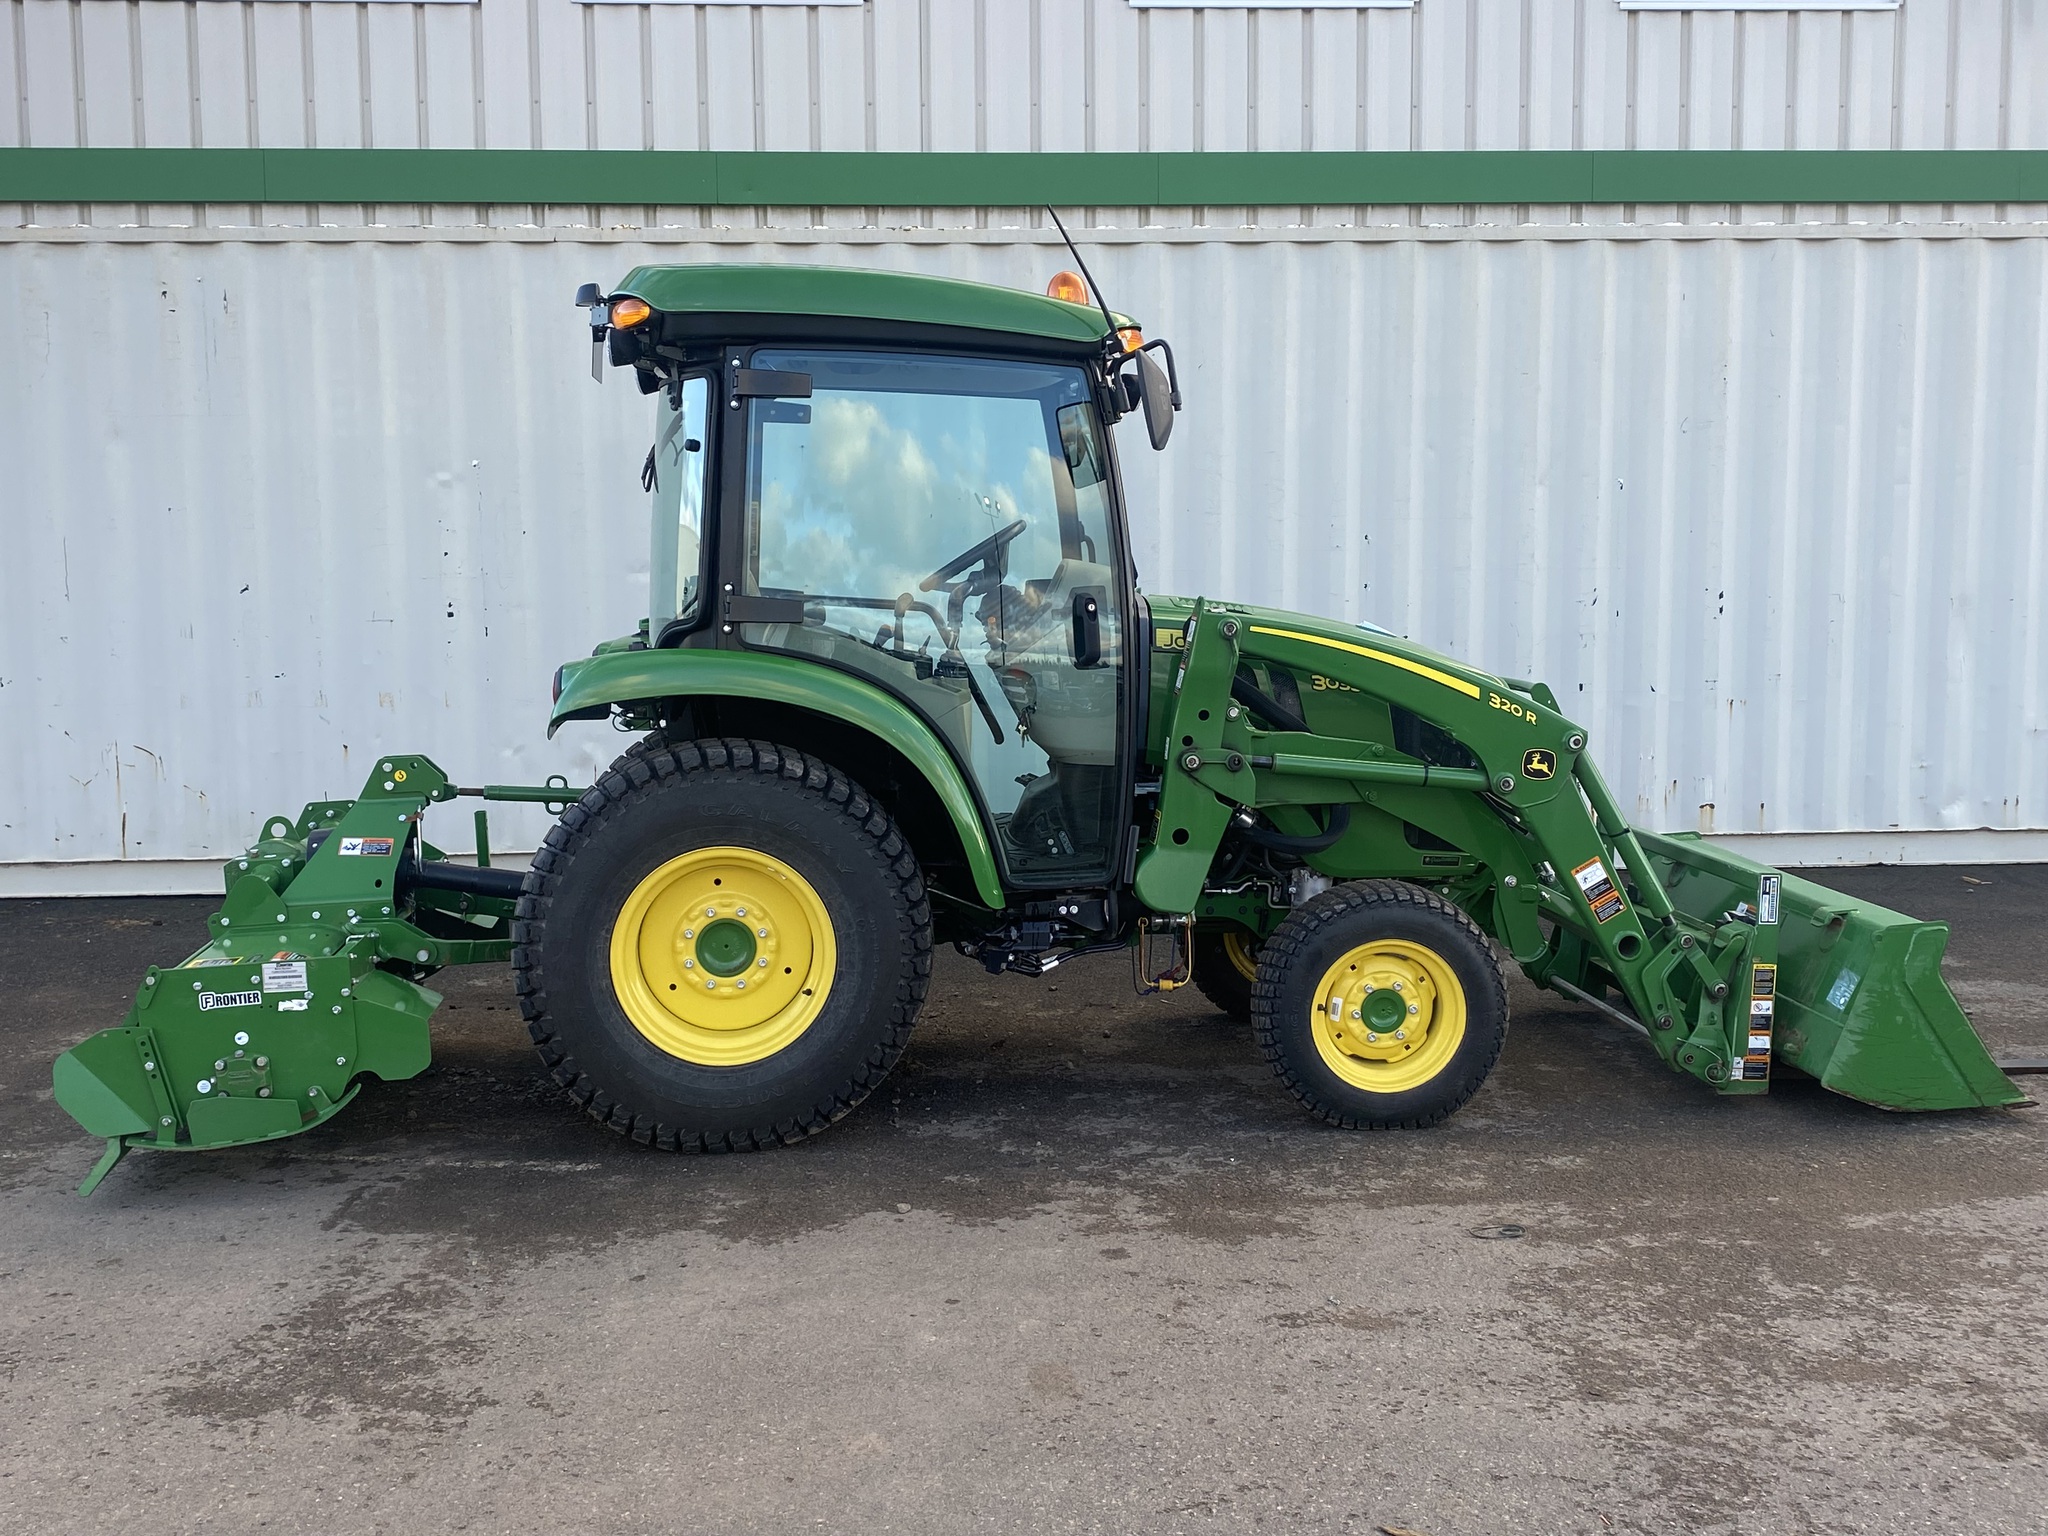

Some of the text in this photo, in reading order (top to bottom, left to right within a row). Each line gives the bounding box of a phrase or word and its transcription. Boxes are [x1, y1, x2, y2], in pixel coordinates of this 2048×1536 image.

[1488, 692, 1537, 726] 320 R
[200, 992, 260, 1010] FRONTIER
